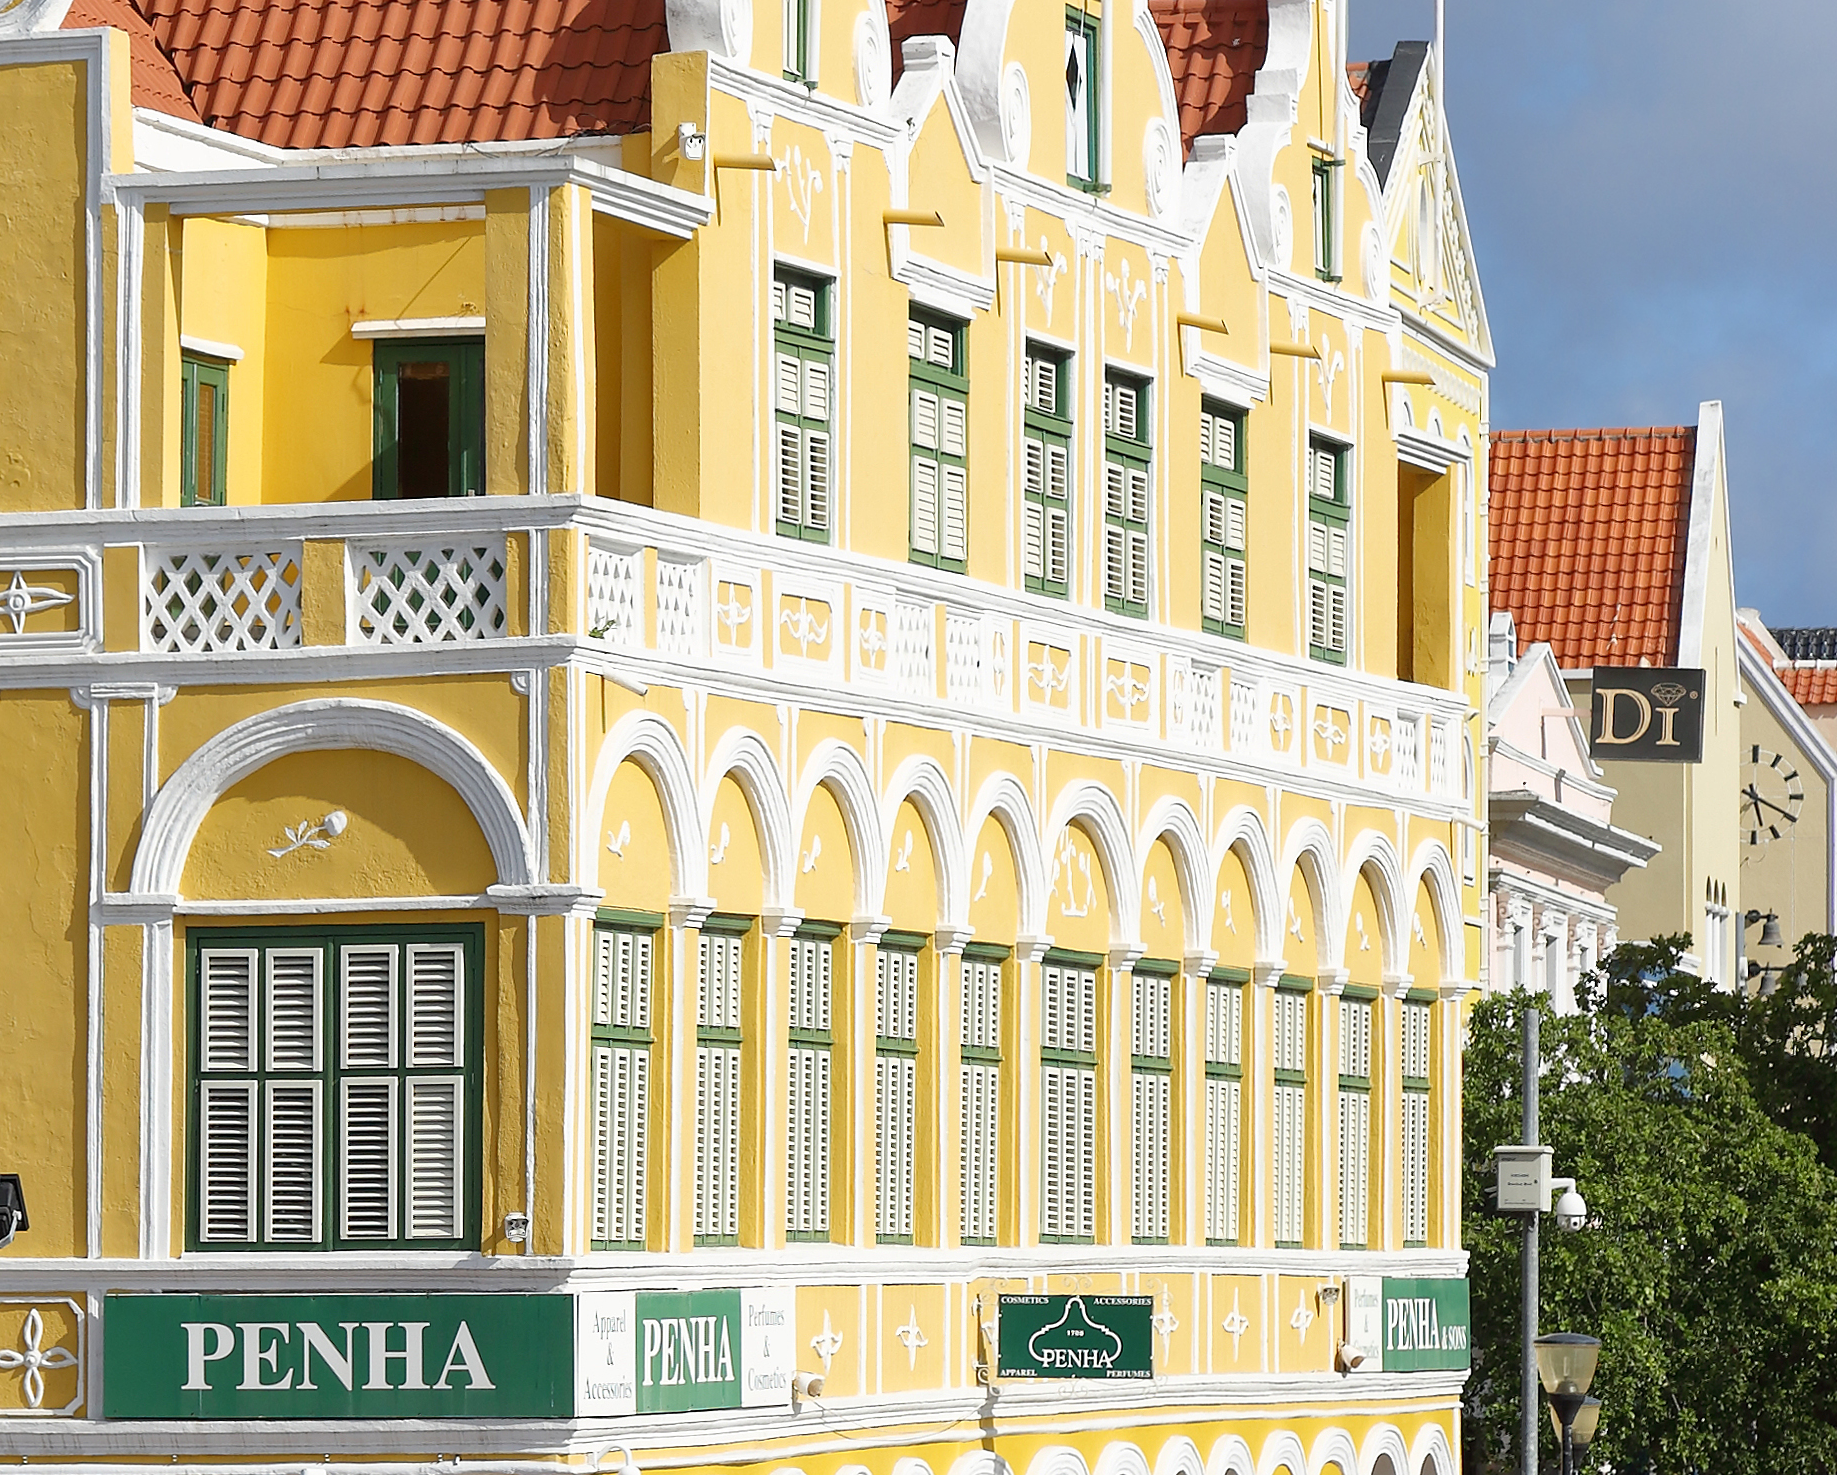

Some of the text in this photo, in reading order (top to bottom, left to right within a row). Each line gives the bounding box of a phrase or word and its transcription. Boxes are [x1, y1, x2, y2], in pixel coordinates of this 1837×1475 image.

[1001, 1296, 1049, 1304] COSMETICS
[1093, 1297, 1152, 1306] ACCESSORIES
[593, 1309, 626, 1340] Apparel
[748, 1304, 785, 1327] Perfumes
[1387, 1298, 1440, 1350] PENHA
[1448, 1326, 1467, 1350] SONS
[181, 1319, 497, 1391] PENHA
[606, 1342, 614, 1365] &
[642, 1315, 735, 1387] PENHA
[763, 1335, 770, 1358] &
[1042, 1349, 1113, 1368] PENHA
[748, 1367, 786, 1391] Cosmetics
[1106, 1370, 1151, 1378] PERFUMES
[584, 1375, 632, 1400] Accessories
